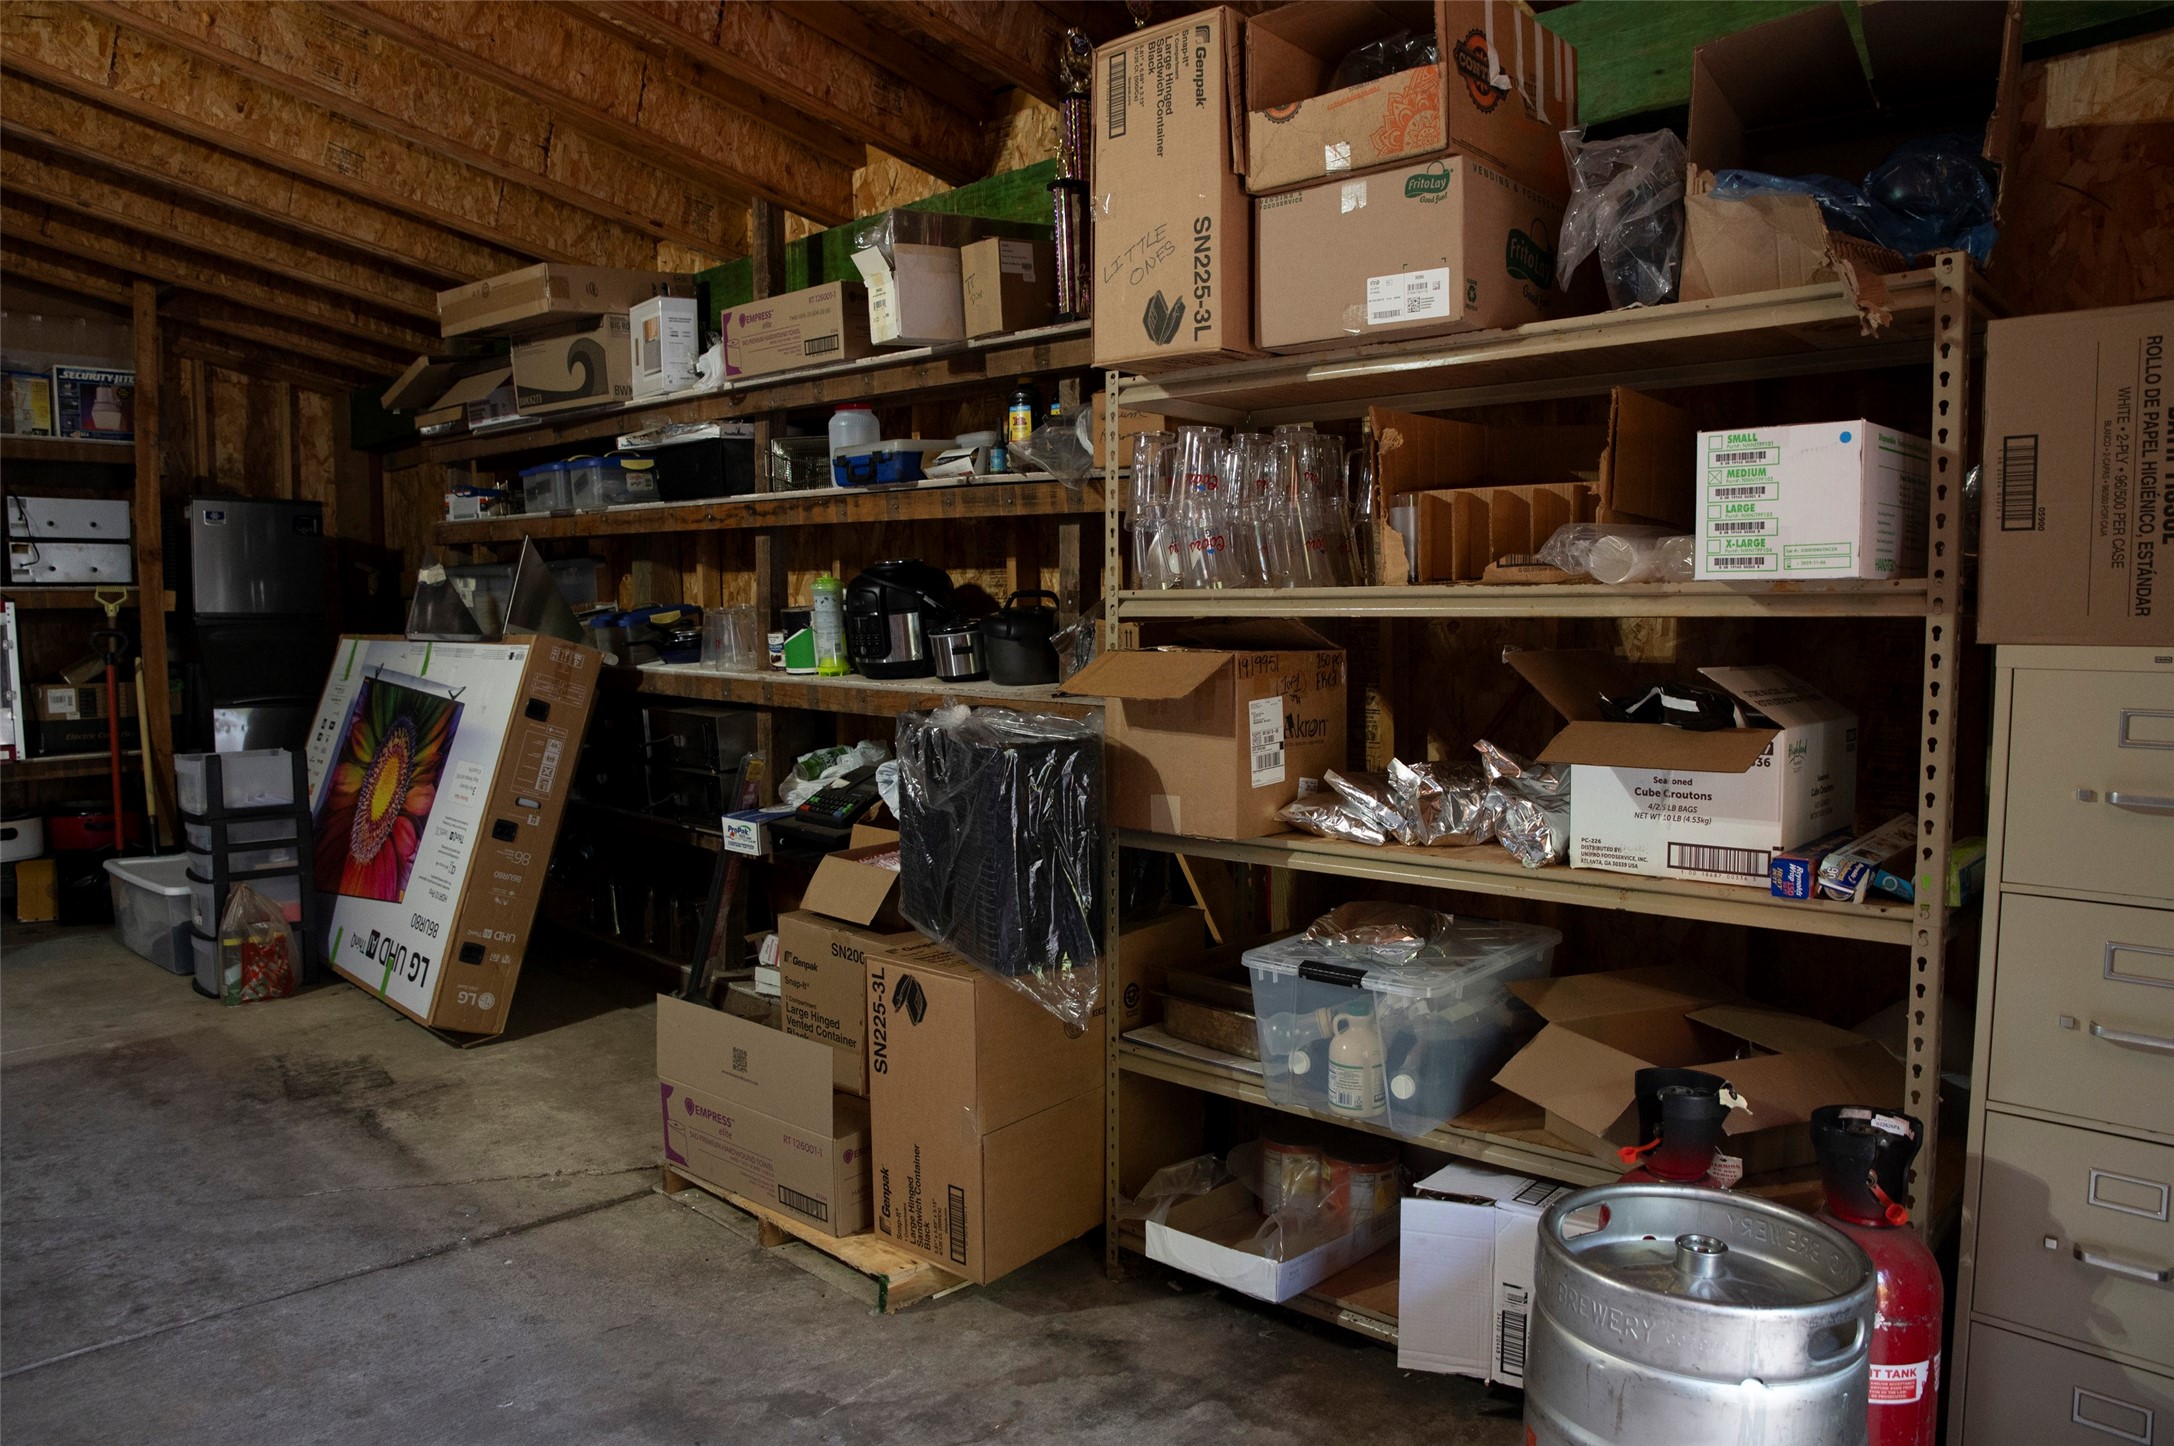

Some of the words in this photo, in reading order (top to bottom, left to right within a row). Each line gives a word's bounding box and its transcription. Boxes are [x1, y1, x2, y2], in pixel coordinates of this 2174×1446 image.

[1148, 41, 1156, 75] Black
[1164, 35, 1173, 70] Large
[1156, 38, 1165, 97] Sandwich
[1193, 47, 1207, 107] Genpak
[1164, 73, 1173, 115] Hinged
[1156, 100, 1165, 157] Container
[1472, 163, 1509, 188] VENDING
[1420, 195, 1435, 204] Good
[1104, 223, 1167, 283] LITTLE
[1130, 240, 1175, 285] ONES
[1193, 216, 1211, 341] SN225-3L
[610, 321, 620, 329] BIG
[746, 310, 772, 324] EMPRESS
[2145, 335, 2163, 384] ROLLO
[2117, 386, 2131, 424] WHITE
[2143, 388, 2161, 408] DE
[1728, 433, 1757, 443] SMALL
[2103, 420, 2112, 447] BLANCO
[2141, 410, 2160, 456] PAPEL
[2115, 434, 2129, 466] 2-PLY
[1727, 468, 1766, 478] MEDIUM
[2113, 475, 2128, 510] 96/500
[2136, 461, 2158, 538] HIGIÉNICO,
[1726, 504, 1755, 513] LARGE
[2038, 507, 2046, 532] 05900
[2100, 506, 2109, 520] POR
[2099, 521, 2108, 537] CAJA
[2113, 514, 2127, 539] PER
[1190, 536, 1225, 551] Coors
[1726, 539, 1765, 547] X-LARGE
[2111, 541, 2126, 569] CASE
[2135, 542, 2157, 617] ESTÁNDAR
[1284, 713, 1327, 739] Akron
[1752, 757, 1771, 767] 36
[1653, 776, 1692, 786] Seaoned
[1634, 787, 1661, 798] Cube
[1664, 789, 1712, 801] Croutons
[1634, 812, 1649, 820] NET
[1683, 815, 1712, 825] (4.53kg)
[1677, 805, 1697, 813] BAGS
[727, 825, 748, 836] ProPak
[512, 851, 531, 866] 86
[1581, 844, 1613, 852] DISTRIBUTED
[1601, 853, 1637, 862] FOODSERVICE,
[494, 871, 522, 883] 86UR80
[1788, 863, 1797, 882] Wrap
[1795, 866, 1804, 897] Reynolds
[411, 913, 439, 939] 86UR80
[494, 931, 516, 943] UHD
[351, 933, 367, 954] ThinQ
[379, 937, 407, 976] UHD
[793, 957, 818, 971] Genpak
[408, 952, 430, 988] LG
[457, 991, 477, 1005] LG
[789, 996, 817, 1009] Compartment
[786, 1002, 809, 1019] Large
[811, 1010, 840, 1029] Hinged
[872, 967, 887, 1074] SN225-3L
[787, 1014, 814, 1033] Vented
[816, 1026, 857, 1048] Container
[695, 1105, 732, 1127] EMPRESS
[719, 1128, 732, 1139] elite
[783, 1135, 791, 1144] RT
[755, 1156, 774, 1171] TOWEL
[913, 1144, 921, 1195] Container
[880, 1167, 891, 1218] Genpak
[907, 1176, 915, 1213] Hinged
[923, 1222, 931, 1251] Black
[1558, 1283, 1655, 1344] BREWERY
[1885, 1367, 1917, 1378] TANK
